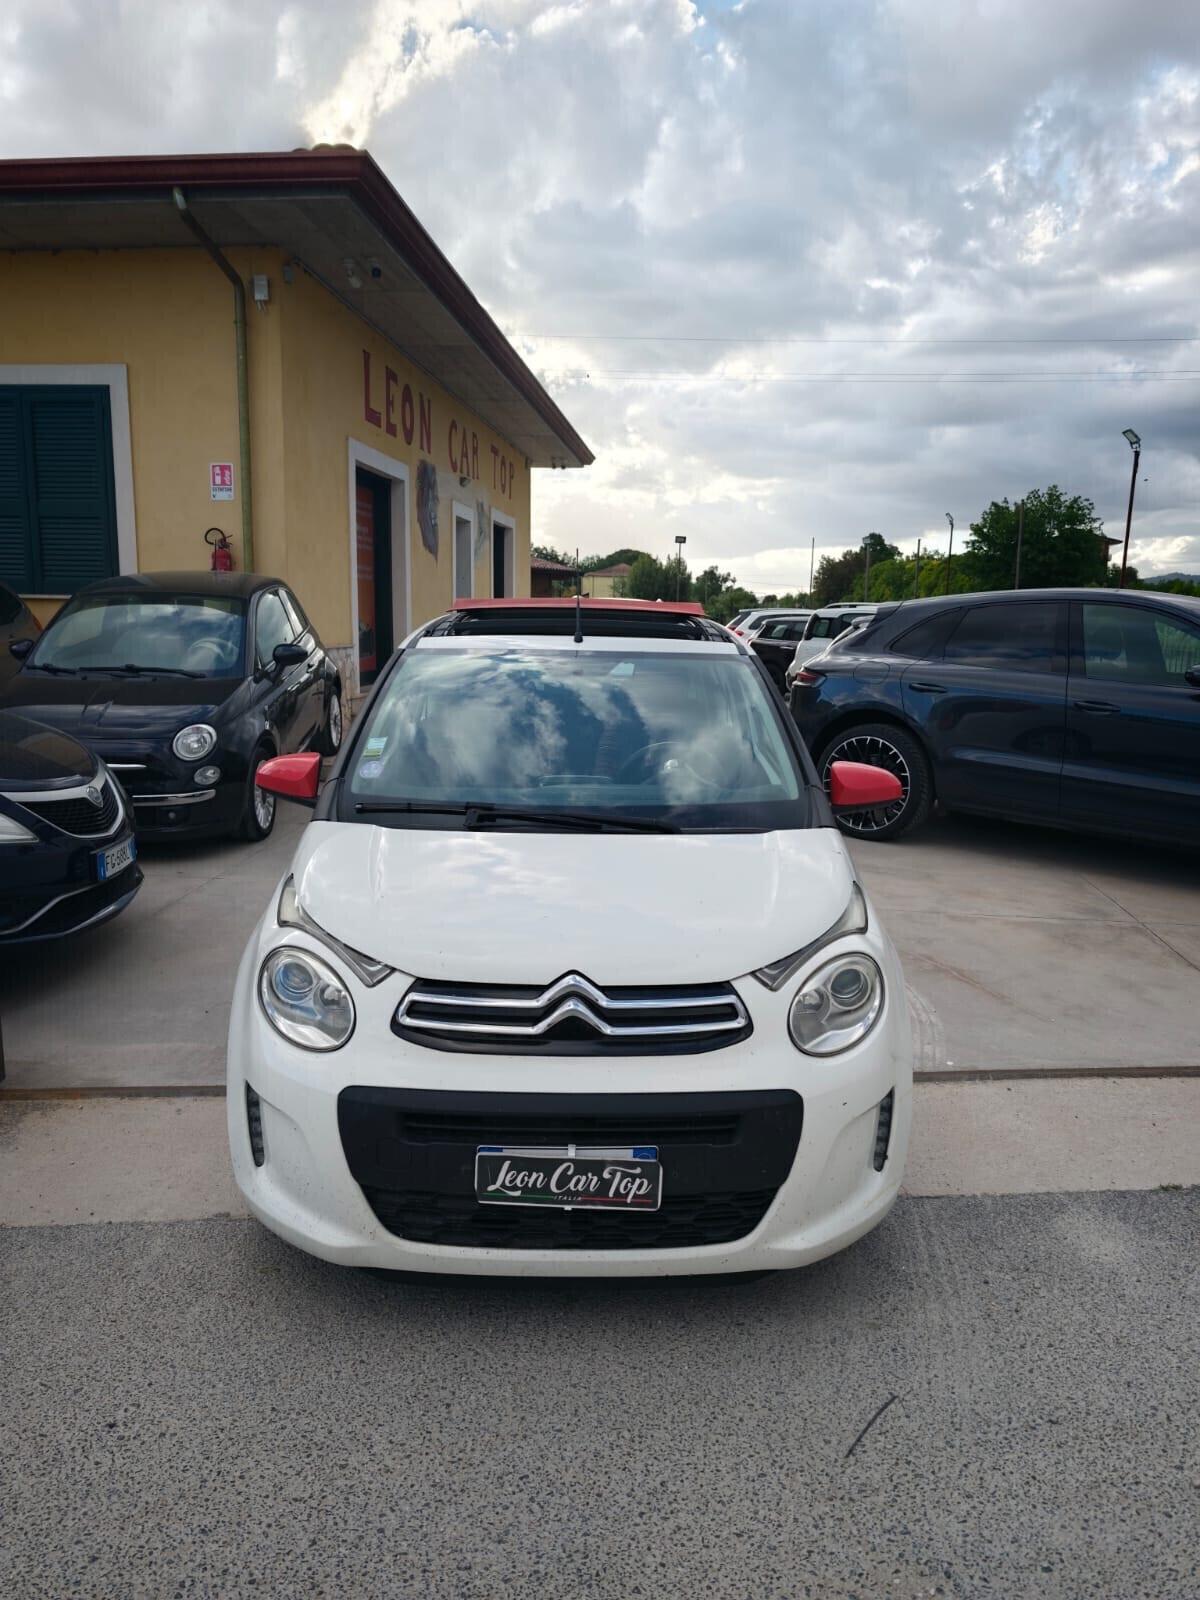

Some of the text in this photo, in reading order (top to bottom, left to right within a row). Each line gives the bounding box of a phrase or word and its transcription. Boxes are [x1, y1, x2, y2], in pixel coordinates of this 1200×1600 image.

[363, 349, 516, 500] LEON CAR TOP
[486, 1160, 652, 1203] Leon Car Top
